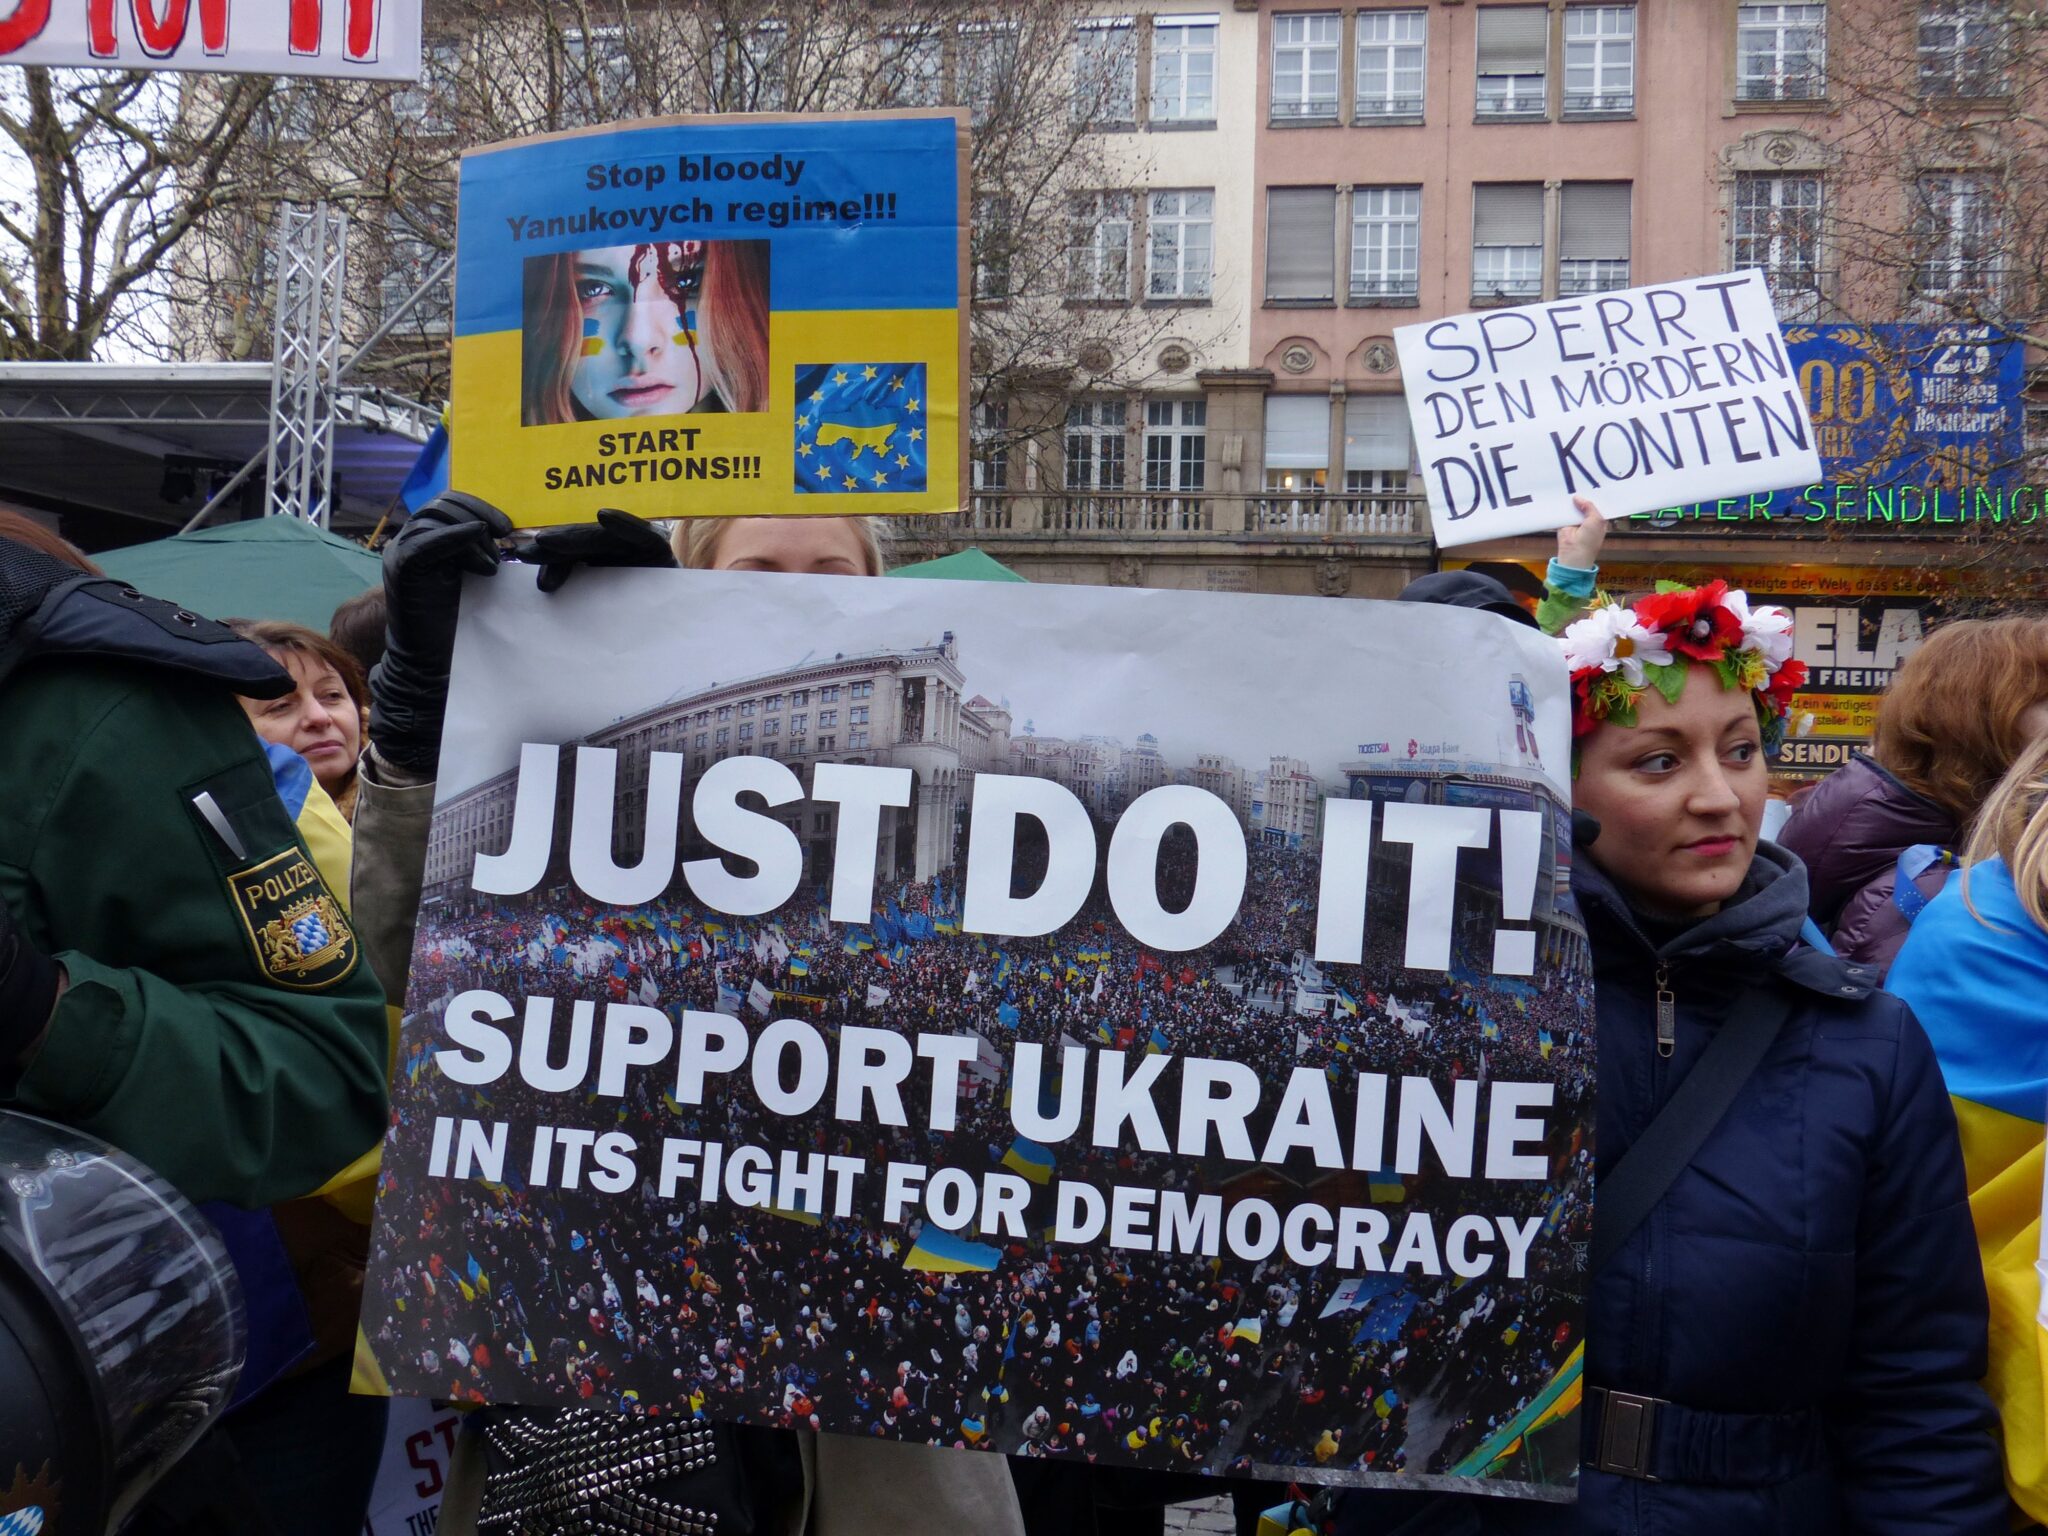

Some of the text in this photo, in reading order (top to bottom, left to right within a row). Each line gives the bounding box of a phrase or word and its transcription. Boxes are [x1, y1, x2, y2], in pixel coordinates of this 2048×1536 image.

[585, 153, 805, 192] Stop bloody
[506, 193, 897, 243] Yanukovych regime!!!
[1424, 278, 1751, 382] SPERRT
[1424, 332, 1789, 439] DEN MÖRDERN
[597, 428, 701, 457] START
[1550, 390, 1810, 494] KONTEN
[544, 455, 762, 490] SANCTIONS!!!
[1803, 484, 2048, 525] SENDLING
[1791, 576, 1814, 589] der
[1772, 605, 1924, 668] ELA
[1819, 670, 1897, 687] FREIH
[1823, 698, 1872, 713] würdiges
[1780, 743, 1874, 764] SENDL
[471, 742, 1543, 976] JUST DO IT!
[434, 988, 1555, 1181] SUPPORT UKRAINE
[428, 1116, 1544, 1279] IN ITS FIGHT FOR DEMOCRACY
